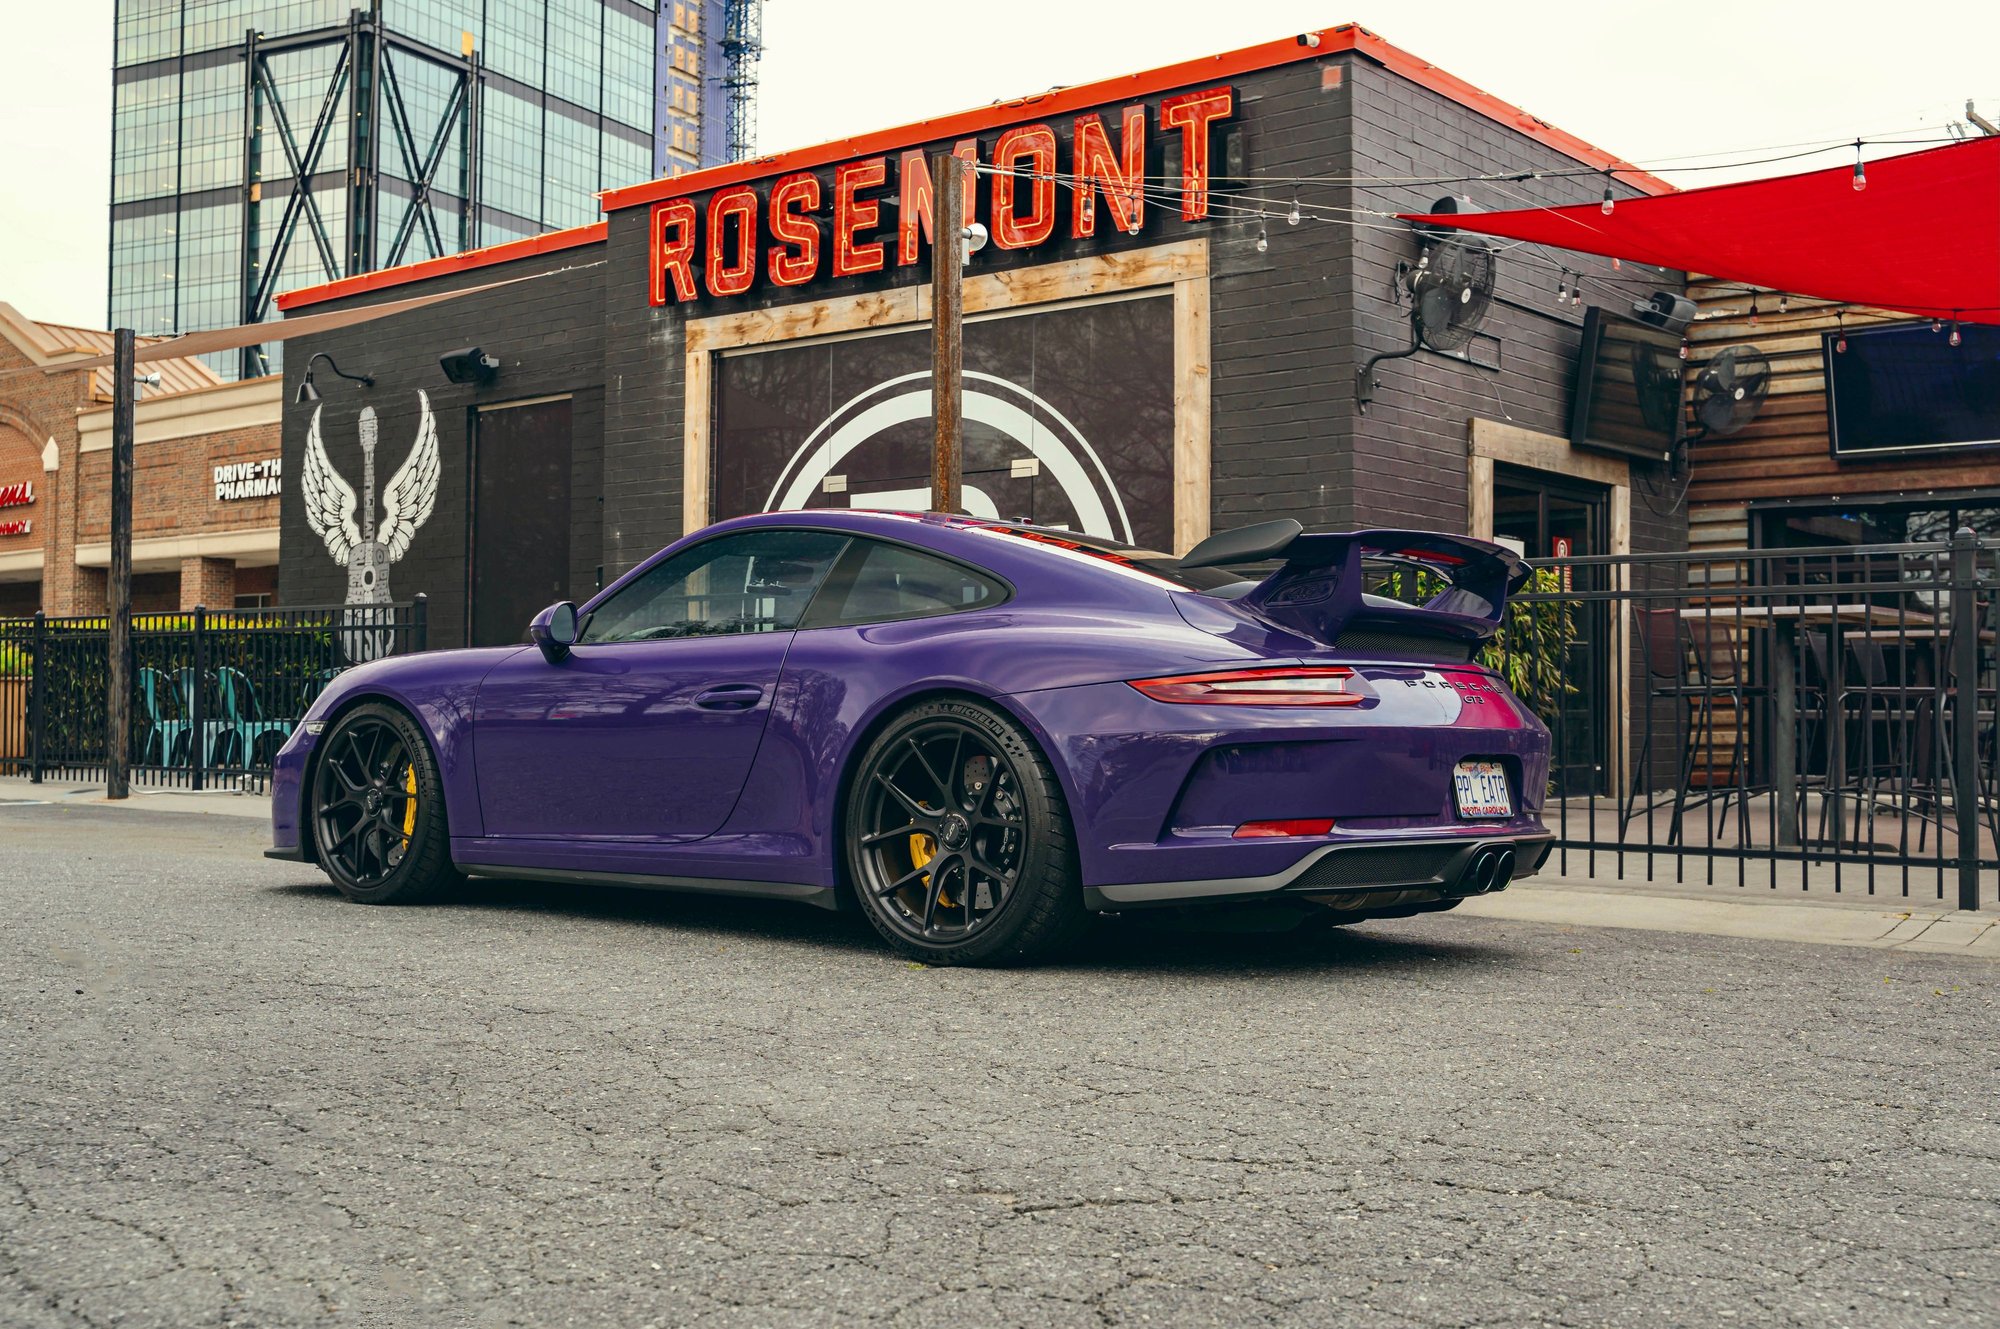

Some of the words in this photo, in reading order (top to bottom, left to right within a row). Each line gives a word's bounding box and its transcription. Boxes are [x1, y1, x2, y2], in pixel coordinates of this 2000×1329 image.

[648, 85, 1235, 308] ROSEMONT
[1404, 680, 1503, 694] PORSCHE
[1464, 694, 1485, 705] GT3
[950, 704, 1005, 738] MICHELIN
[1456, 775, 1478, 804] PPL
[1480, 775, 1508, 804] EATR
